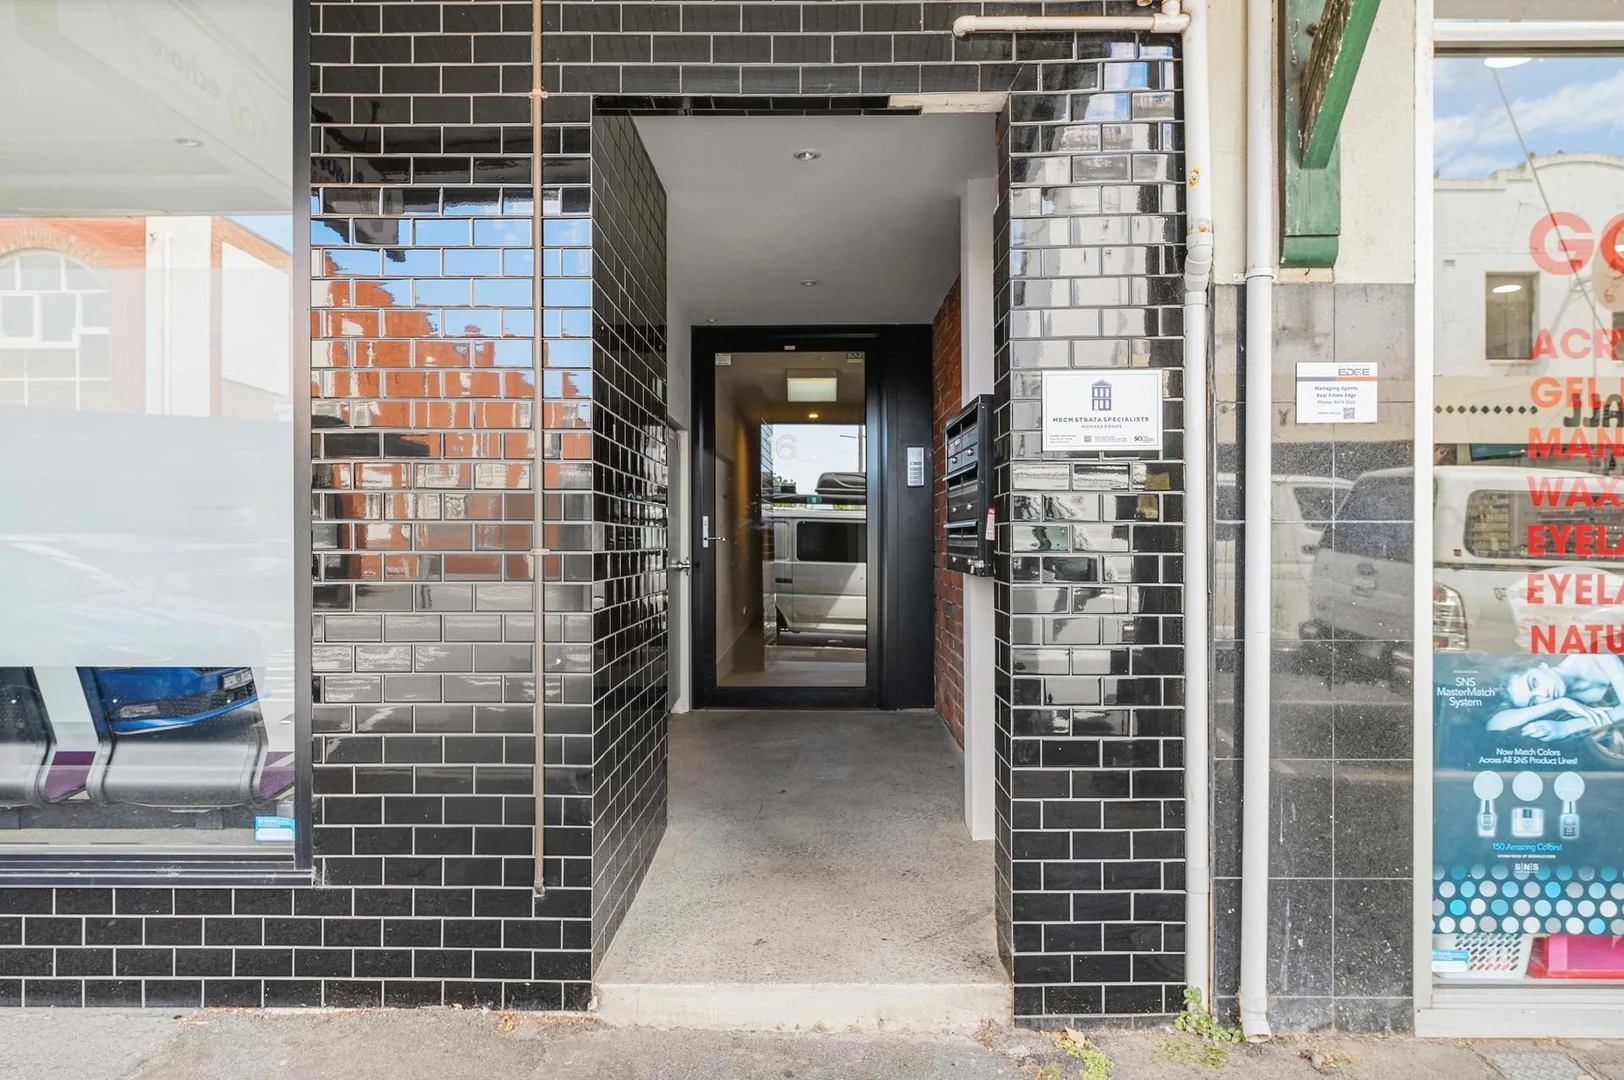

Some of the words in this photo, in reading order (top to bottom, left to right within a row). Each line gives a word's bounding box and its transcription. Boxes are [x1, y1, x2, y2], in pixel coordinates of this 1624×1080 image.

[1530, 328, 1624, 360] ACR
[1338, 368, 1370, 376] EDGE
[1530, 377, 1603, 408] GEL
[1527, 427, 1624, 459] MAN
[1526, 476, 1624, 507] WAX
[1531, 625, 1624, 655] NATU
[1455, 677, 1476, 687] SNS
[1449, 697, 1482, 709] System
[1496, 748, 1513, 756] Now
[1514, 748, 1536, 756] Match
[1537, 748, 1561, 756] Colors
[1478, 756, 1501, 764] Across
[1502, 756, 1512, 764] All
[1512, 756, 1528, 764] SNS
[1492, 843, 1505, 851] 150
[1506, 843, 1536, 852] Amazing
[1536, 843, 1562, 851] Colors!
